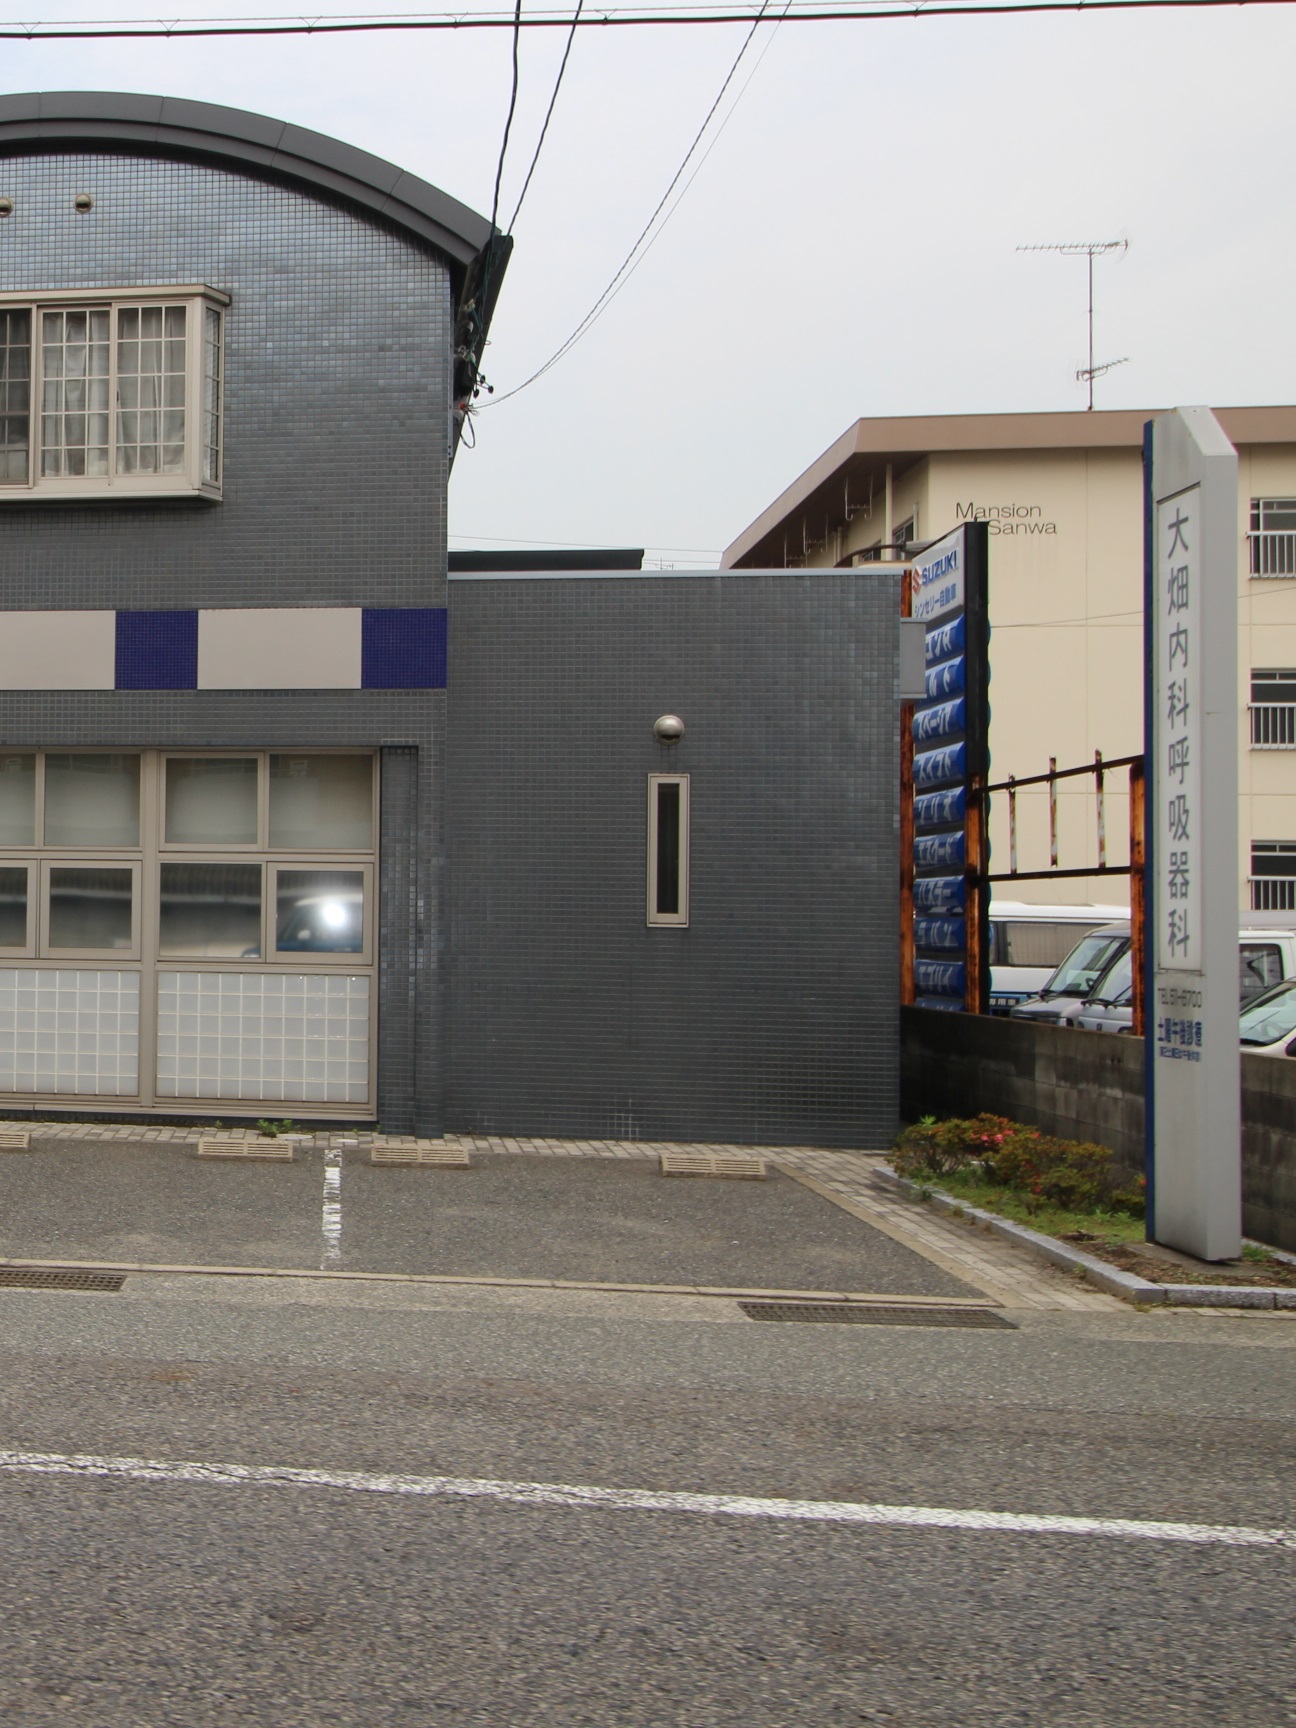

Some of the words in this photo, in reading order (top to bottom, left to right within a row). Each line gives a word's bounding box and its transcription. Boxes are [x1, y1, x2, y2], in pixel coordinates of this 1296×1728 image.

[956, 502, 1042, 519] Mansion
[988, 519, 1057, 535] Sanwa
[922, 550, 957, 586] SUZUKI
[914, 583, 957, 618] シンセリー自動車
[917, 703, 953, 740] スペーシア
[1167, 506, 1190, 959] 大畑内科呼吸器科
[918, 751, 952, 783] スイフト
[918, 796, 952, 825] ソリオ
[918, 838, 953, 865] エスクード
[918, 880, 951, 906] ハスラー
